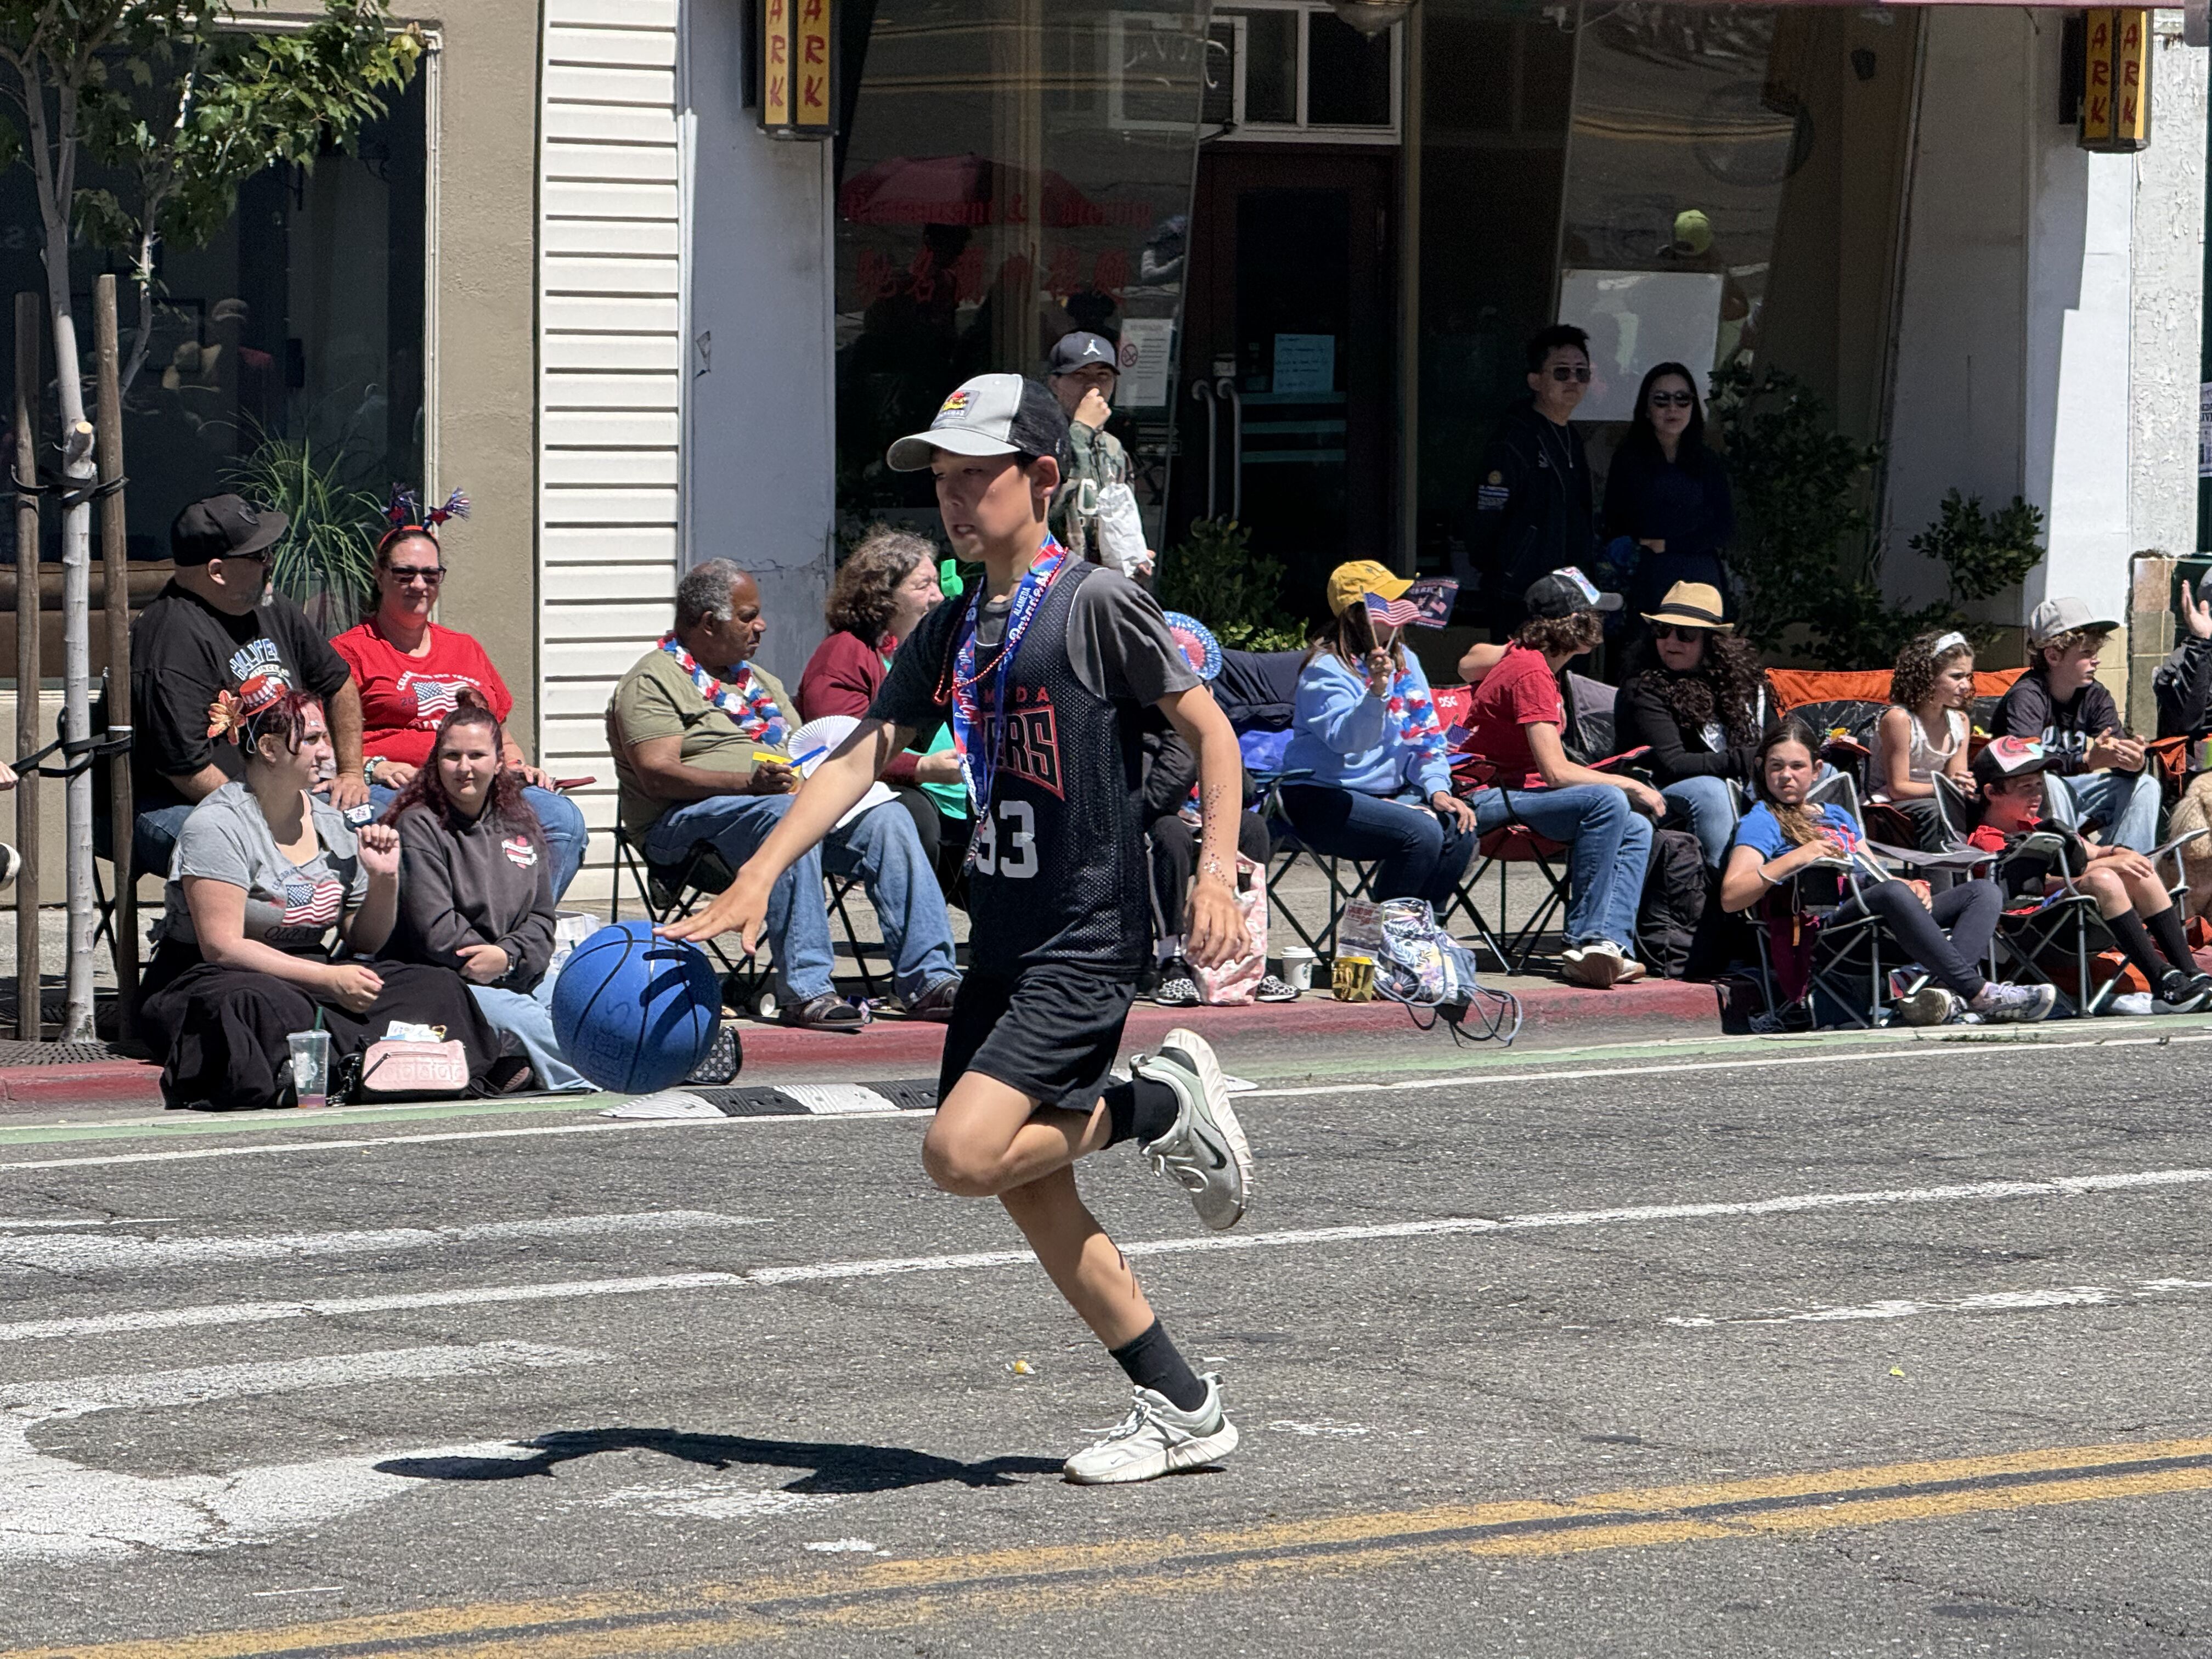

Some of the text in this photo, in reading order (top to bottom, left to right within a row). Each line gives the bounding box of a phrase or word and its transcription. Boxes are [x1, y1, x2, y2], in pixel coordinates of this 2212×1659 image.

[803, 0, 826, 108] ARK
[2091, 22, 2109, 124] ARK
[1013, 586, 1032, 617] ALAMEDA
[954, 689, 979, 725] July!
